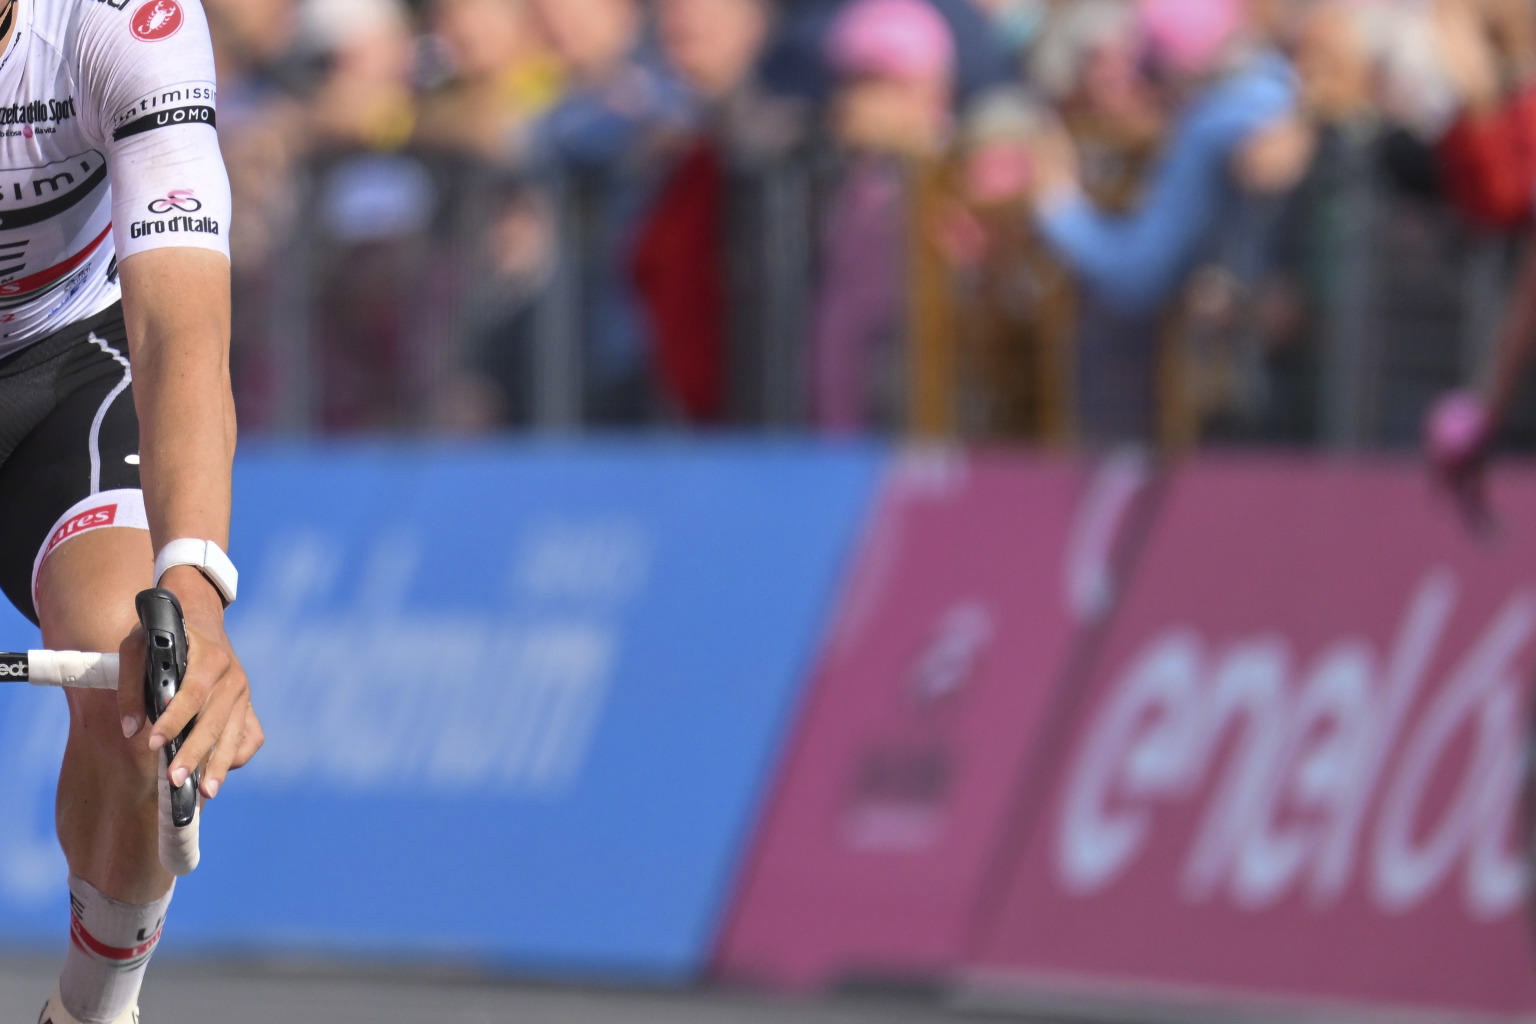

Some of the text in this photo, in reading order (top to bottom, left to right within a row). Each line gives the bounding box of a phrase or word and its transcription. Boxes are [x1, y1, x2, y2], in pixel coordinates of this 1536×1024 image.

[156, 108, 209, 125] UOMO
[130, 216, 219, 239] Giro d'Italia
